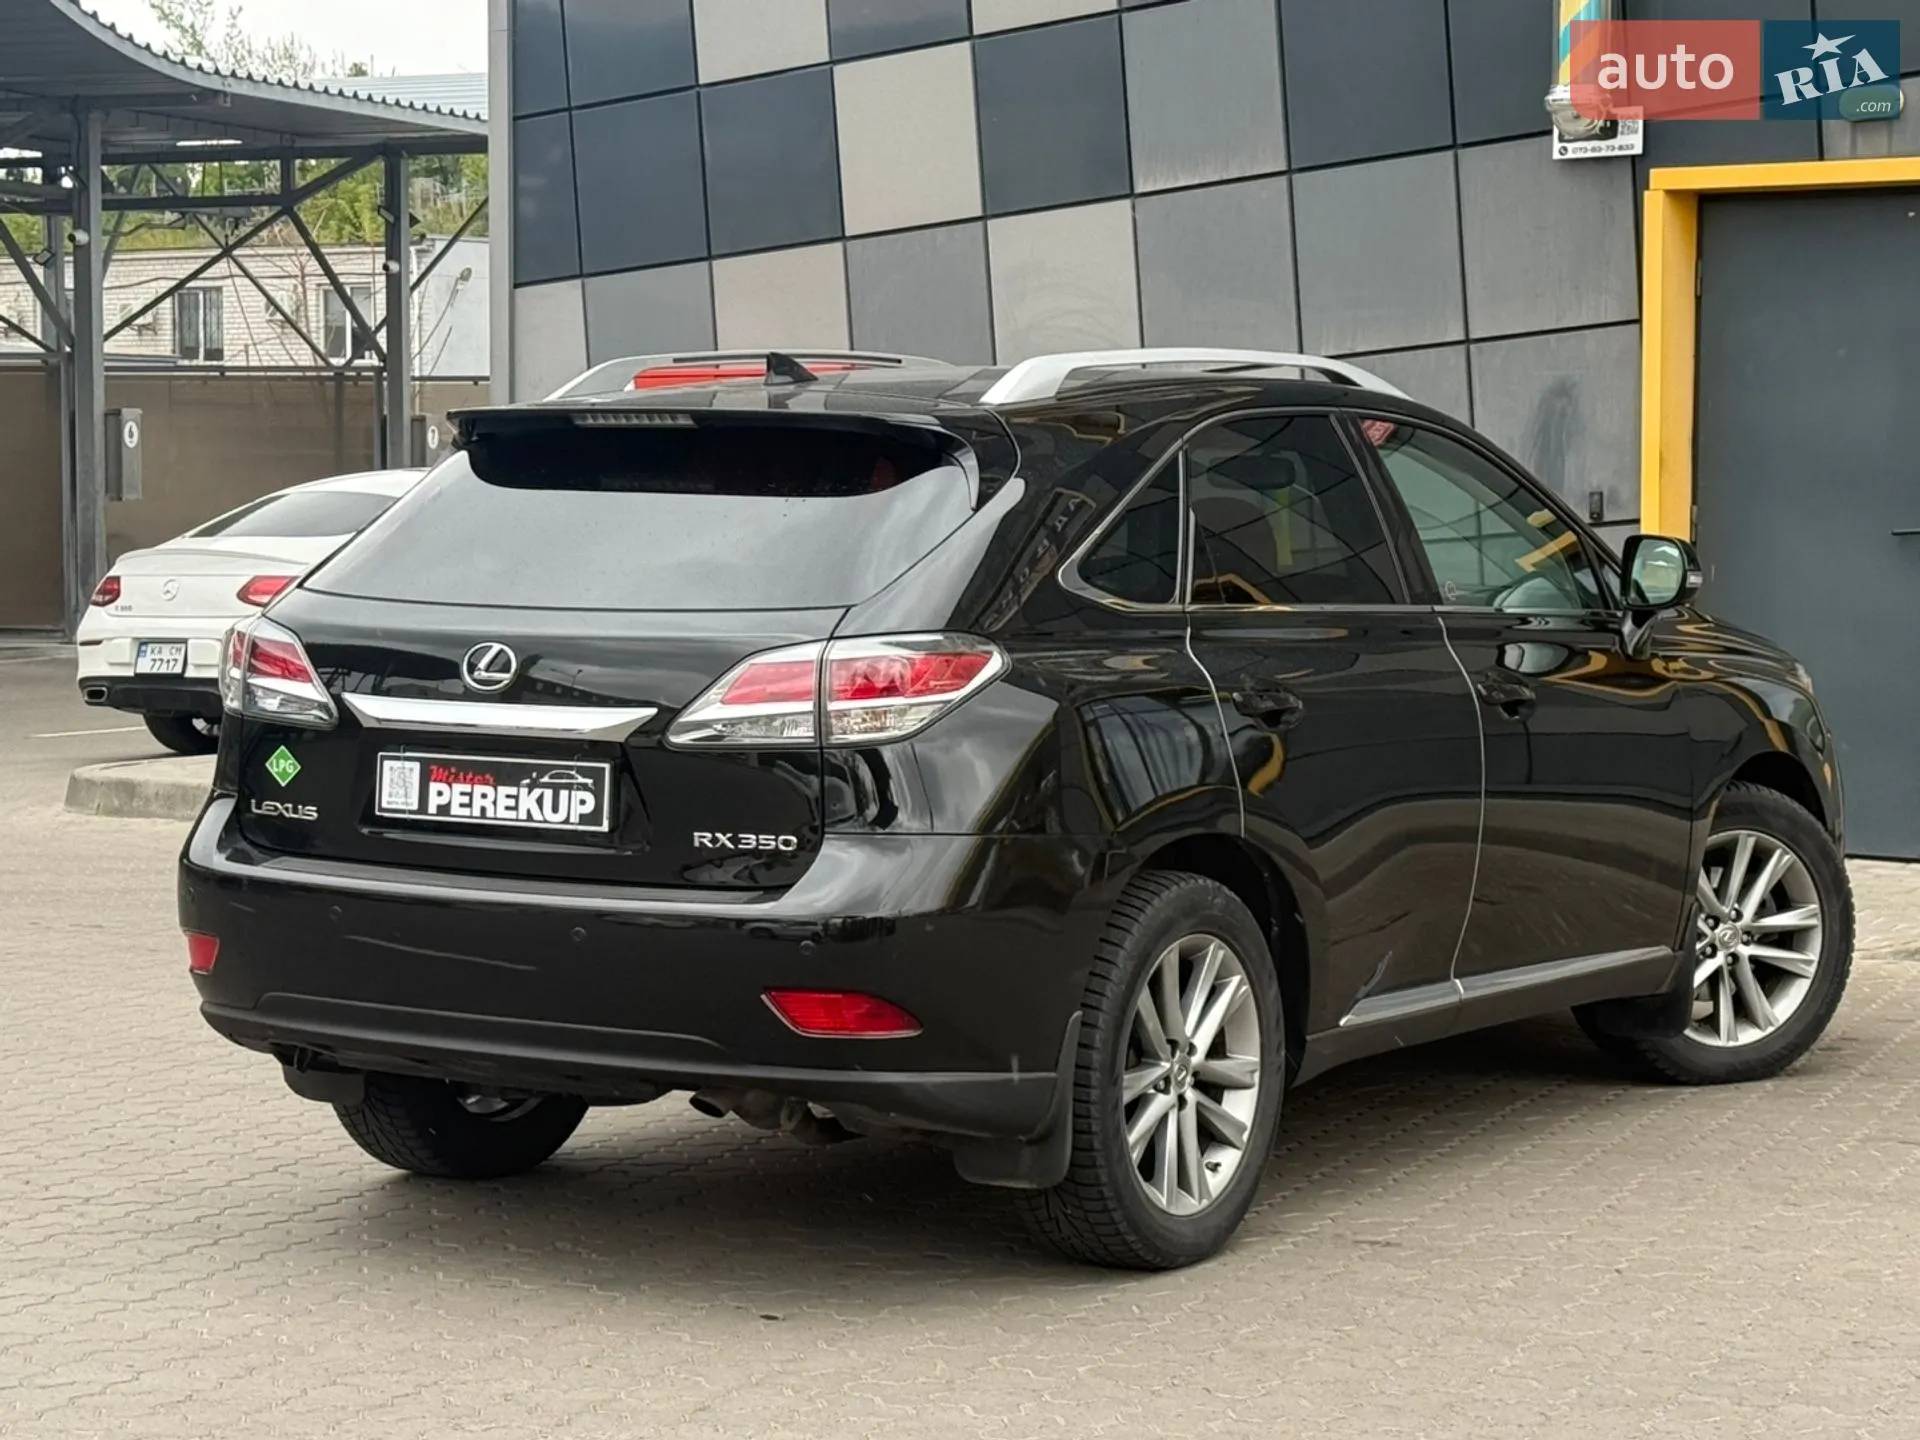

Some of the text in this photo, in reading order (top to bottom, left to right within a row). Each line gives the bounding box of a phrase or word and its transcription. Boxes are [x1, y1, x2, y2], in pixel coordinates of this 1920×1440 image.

[128, 424, 135, 440] 6
[150, 658, 178, 671] 7717
[273, 759, 294, 773] LPG
[429, 765, 495, 784] Mister
[250, 798, 319, 821] LEXUS
[427, 781, 595, 824] PEREKUP
[693, 831, 798, 851] RX 350
